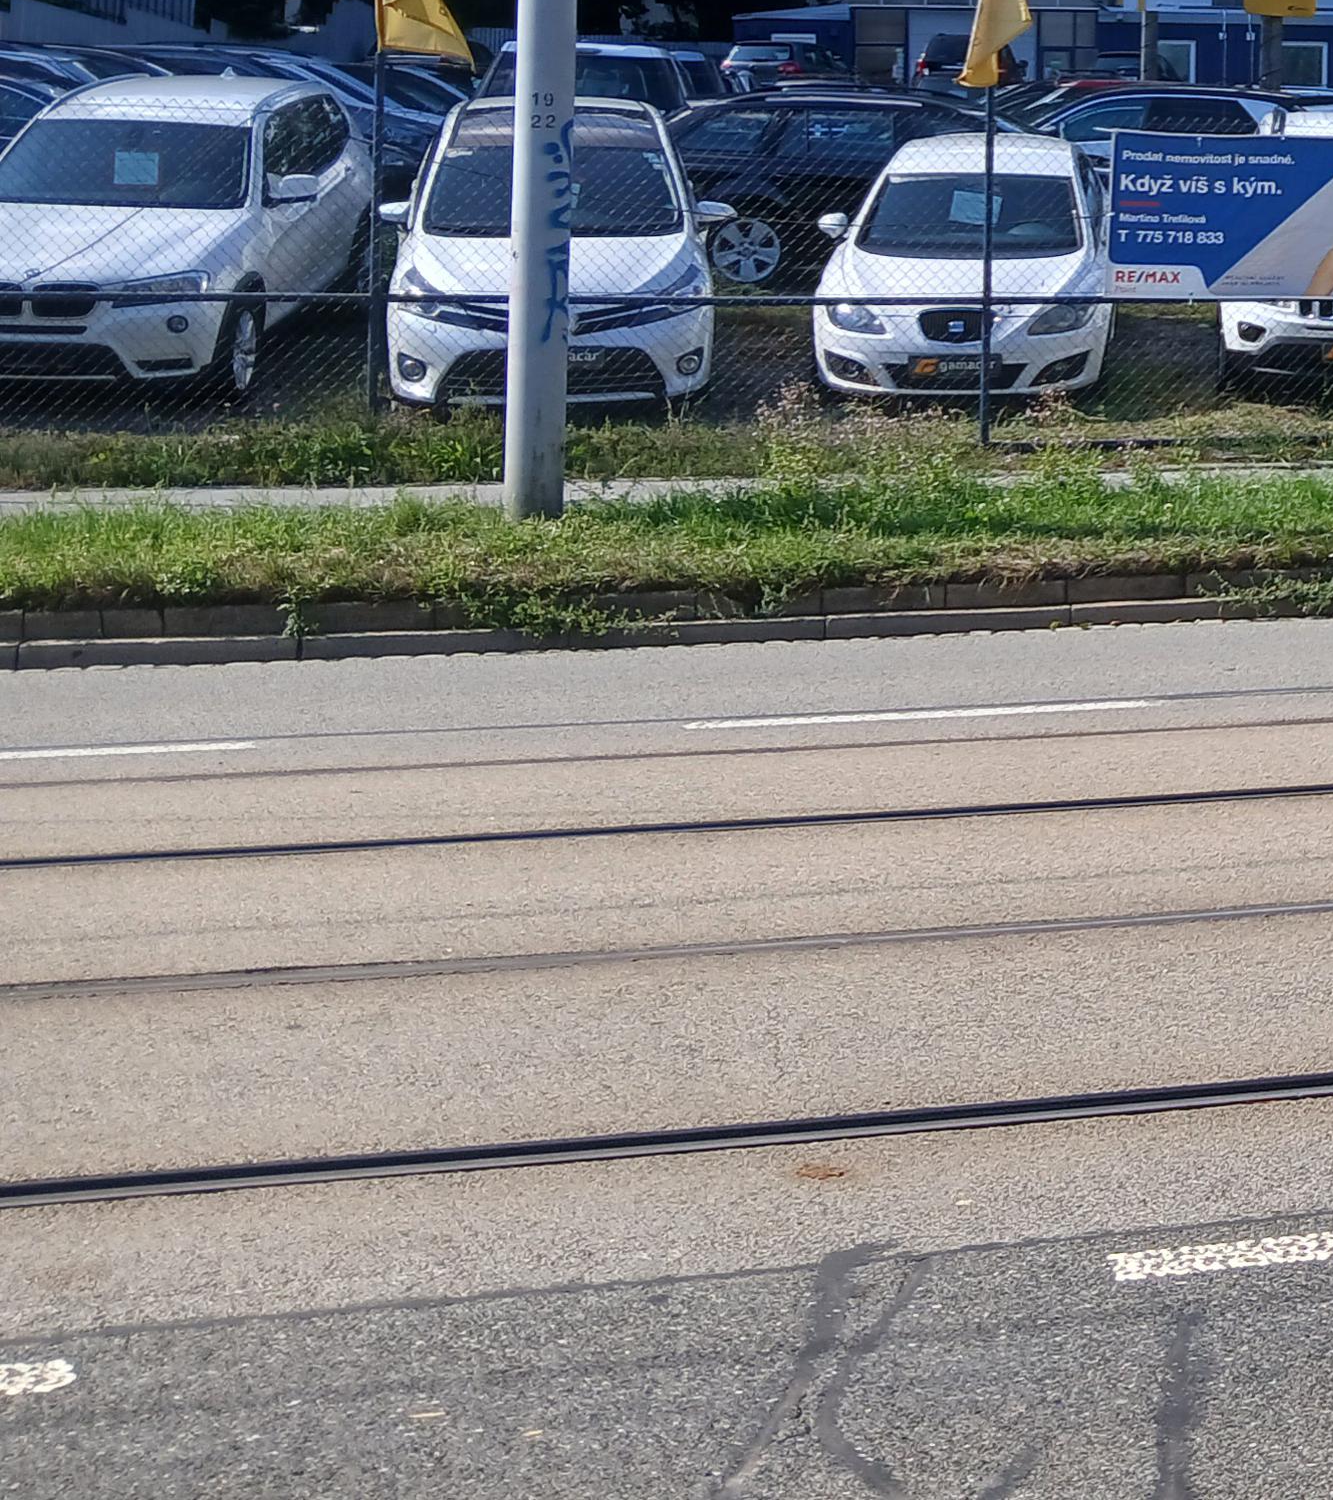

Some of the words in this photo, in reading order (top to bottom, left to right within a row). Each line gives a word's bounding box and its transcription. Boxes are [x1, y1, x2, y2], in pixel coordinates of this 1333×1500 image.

[532, 92, 554, 107] 19
[531, 115, 556, 128] 22
[1122, 150, 1163, 162] Prodat
[1165, 153, 1232, 165] nemovitost
[1234, 154, 1246, 166] je
[1248, 154, 1295, 165] snadné.
[1120, 173, 1174, 195] Když
[1178, 176, 1208, 194] víš
[1214, 181, 1226, 194] s
[1233, 177, 1283, 197] kým.
[1117, 230, 1129, 242] T
[1136, 231, 1163, 243] 775
[1167, 231, 1194, 243] 718
[1196, 232, 1224, 244] 833
[1115, 271, 1181, 284] RE/MAX
[940, 360, 996, 373] gamacr
